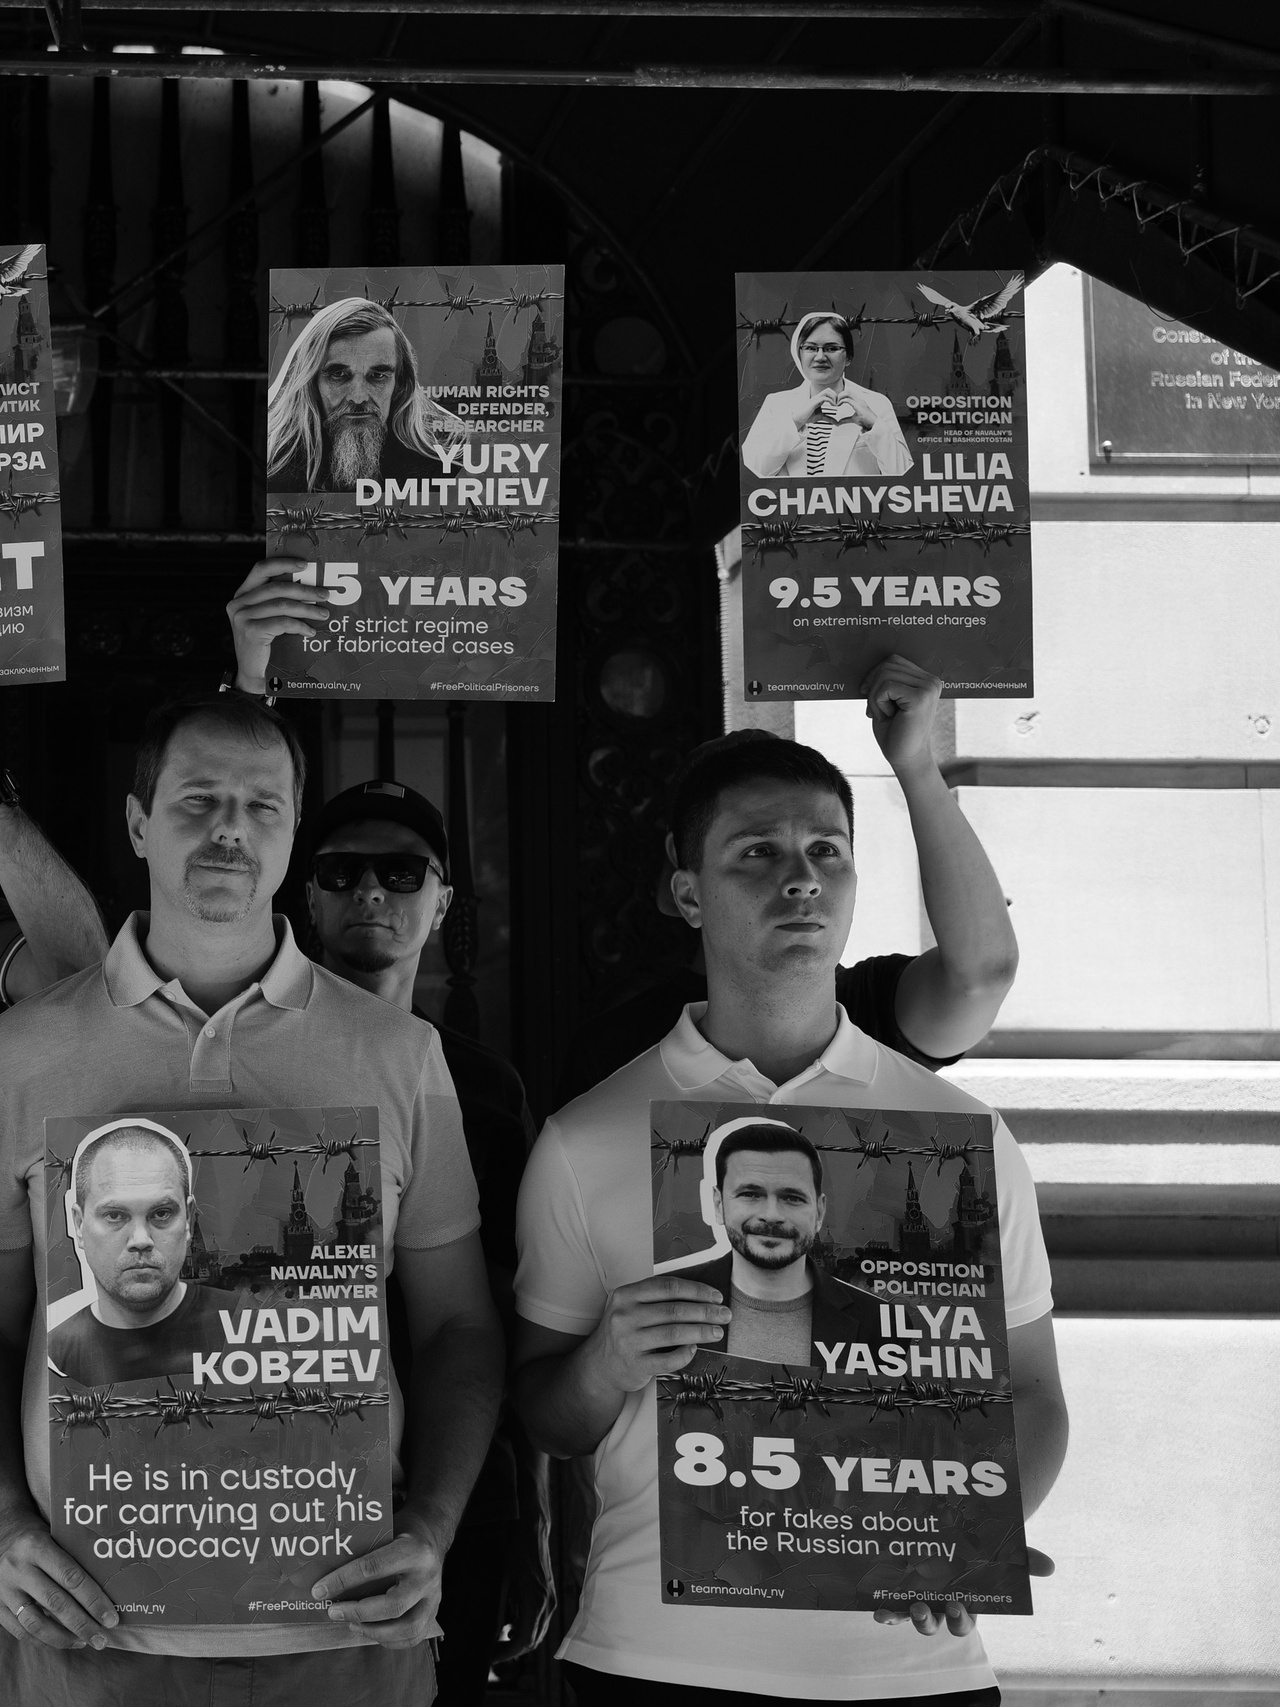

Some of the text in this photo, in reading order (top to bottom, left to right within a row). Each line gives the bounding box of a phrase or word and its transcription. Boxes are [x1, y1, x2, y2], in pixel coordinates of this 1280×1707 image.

[1152, 326, 1216, 343] Consu
[1151, 371, 1223, 387] Russian
[420, 385, 549, 398] HUMAN RIGHTS
[458, 403, 549, 417] DEFENDER,
[906, 396, 1011, 408] OPPOSITION
[433, 420, 544, 433] RESEARCHER
[918, 412, 1012, 424] POLITICIAN
[432, 443, 549, 473] YURY
[923, 453, 1013, 480] LILIA
[356, 478, 548, 505] DMITRIEV
[748, 485, 1014, 516] CHANYSHEVA
[293, 563, 527, 606] 15 YEARS
[769, 576, 1001, 608] 9.5 YEARS
[329, 616, 489, 639] of strict regime
[813, 615, 932, 626] extremism-related
[937, 615, 986, 627] charges
[303, 636, 513, 654] for fabricated cases
[288, 682, 361, 691] teamnavalny_ny
[431, 682, 539, 692] #FreePoliticalPrisoners
[768, 683, 844, 691] teamnavalny_ny
[311, 1245, 376, 1259] ALEXEI
[271, 1265, 377, 1280] NAVALNY'S
[861, 1260, 984, 1278] OPPOSITION
[299, 1285, 377, 1299] LAWYER
[874, 1280, 985, 1297] POLITICIAN
[219, 1306, 379, 1343] VADIM
[880, 1304, 985, 1340] ILYA
[193, 1349, 380, 1384] KOBZEV
[814, 1342, 992, 1379] YASHIN
[674, 1432, 1007, 1496] 8.5 YEARS
[90, 1461, 356, 1494] He is in custody
[64, 1494, 382, 1530] for carrying out his
[740, 1506, 939, 1532] for fakes about
[94, 1528, 353, 1564] advocacy work
[727, 1530, 955, 1561] the Russian army
[691, 1585, 784, 1598] teamnavalny_ny
[873, 1590, 1012, 1602] #FreePoliticalPrisoners
